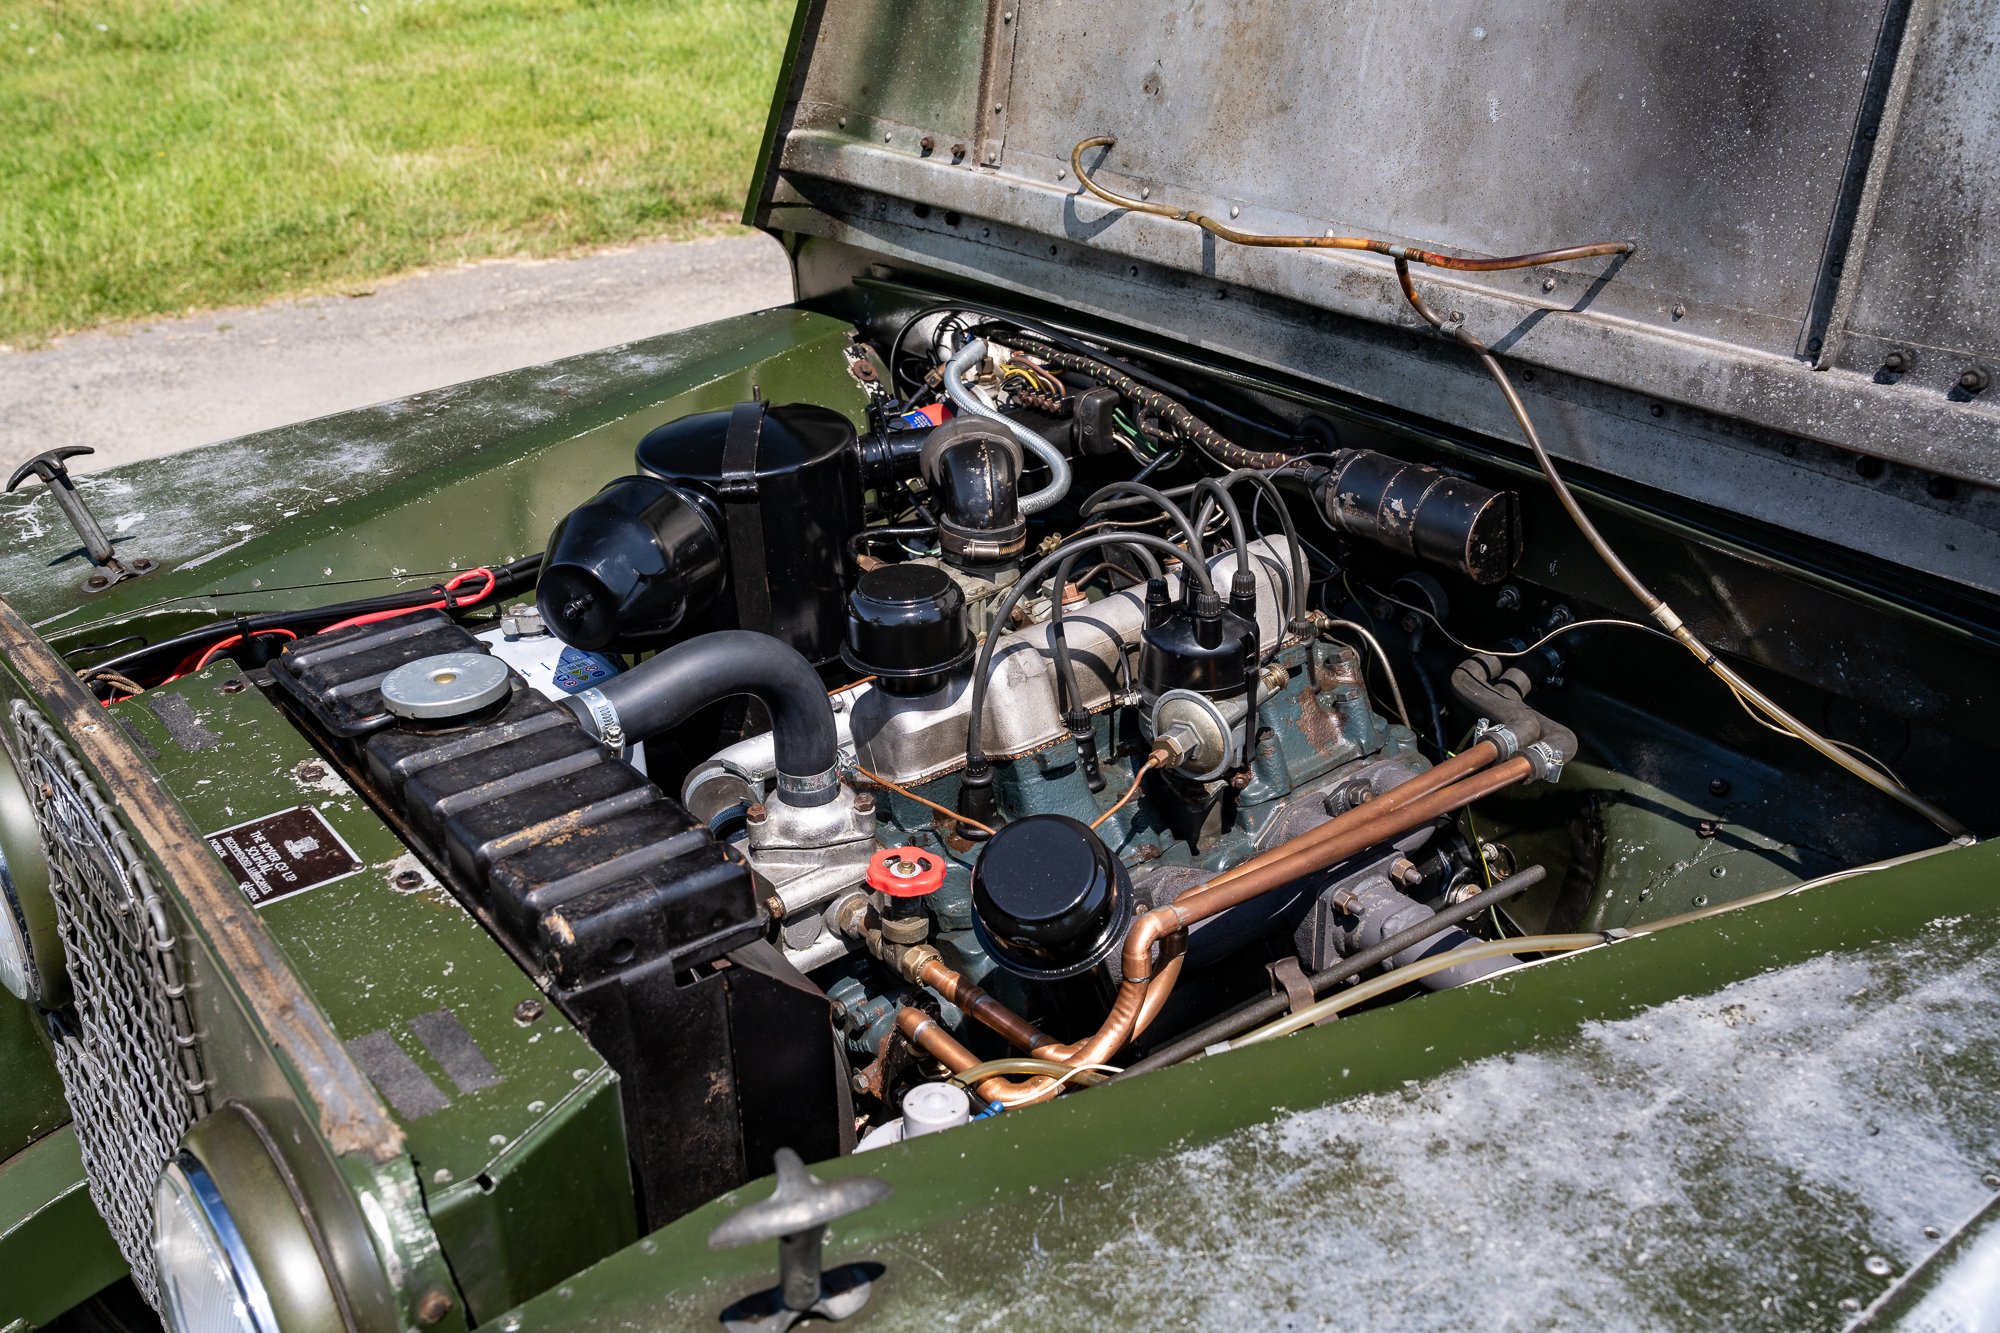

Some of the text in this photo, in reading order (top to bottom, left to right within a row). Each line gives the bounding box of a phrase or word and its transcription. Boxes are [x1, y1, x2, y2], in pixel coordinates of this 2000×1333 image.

[224, 836, 273, 893] RECOMMENDED LUBRICANTS
[250, 830, 267, 844] THE
[259, 839, 282, 863] ROVER
